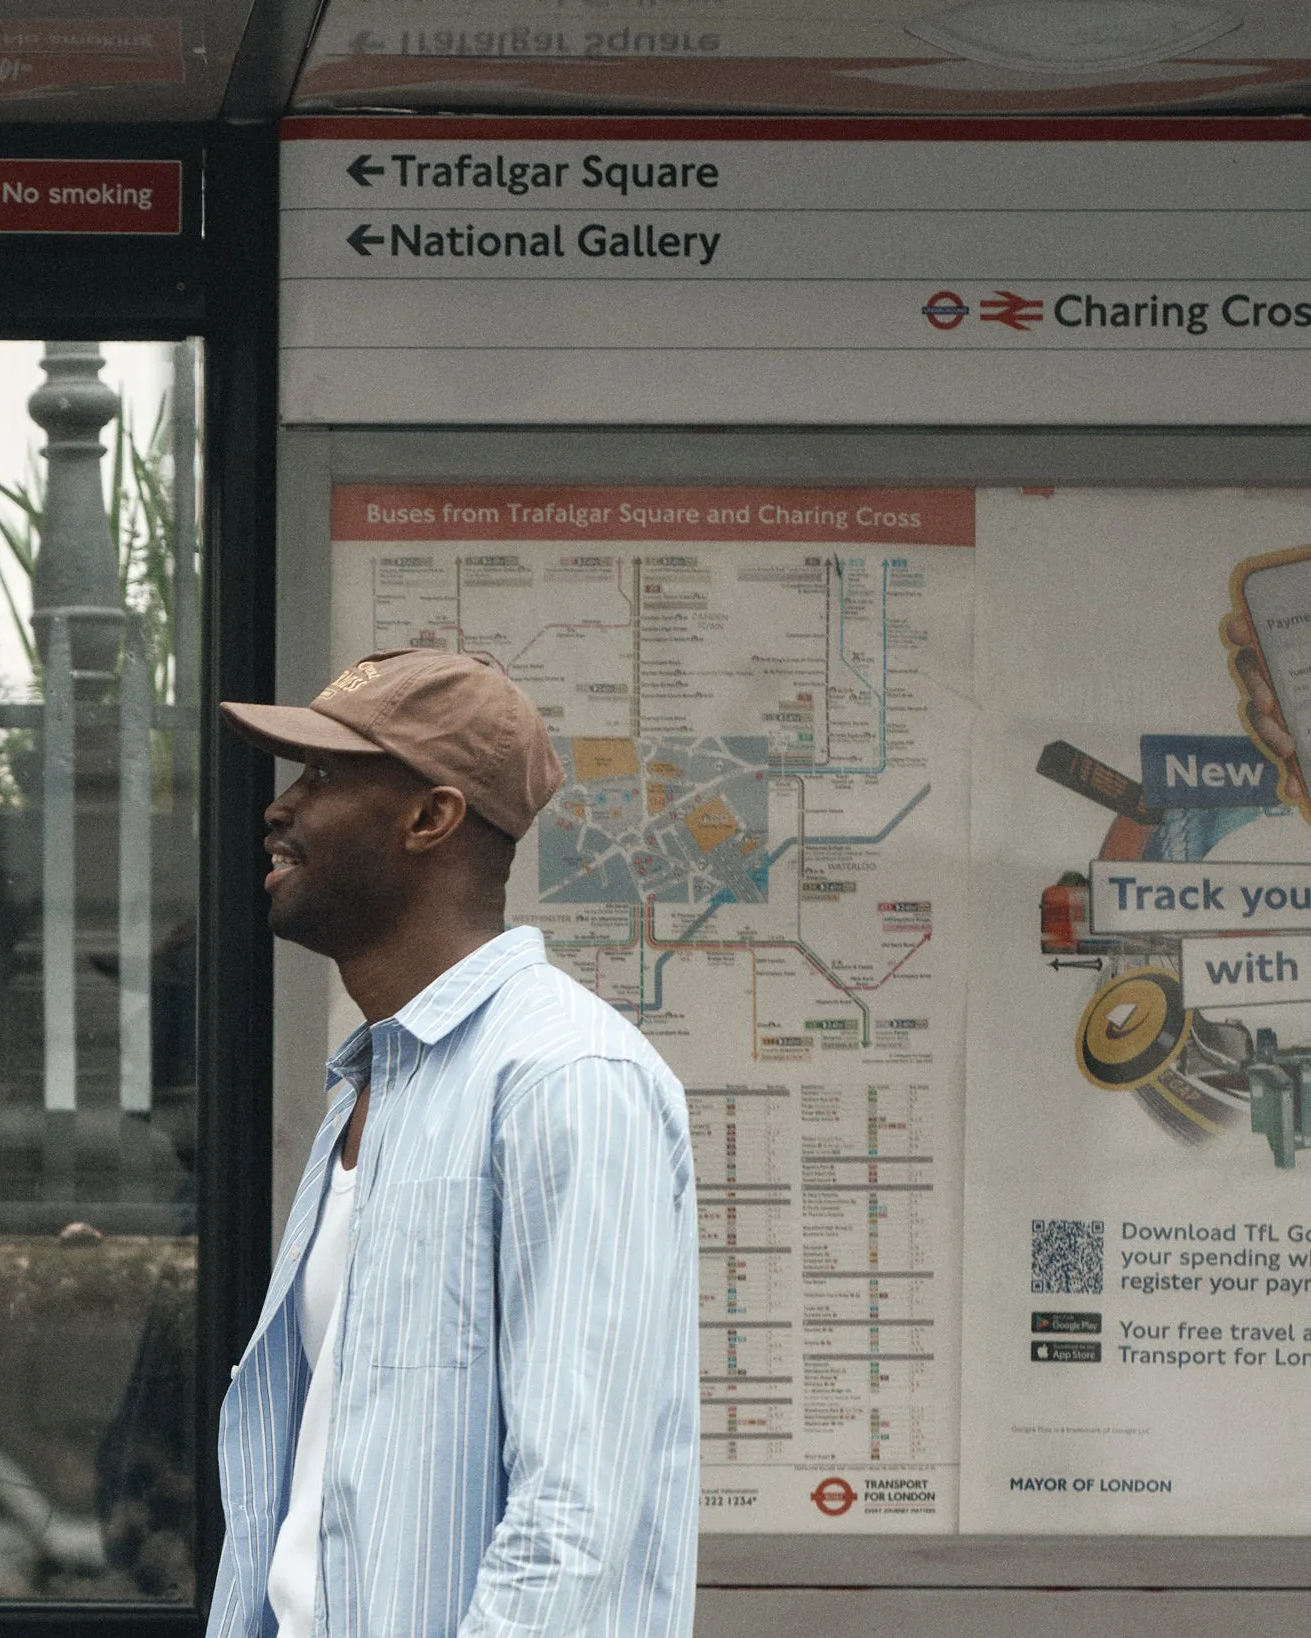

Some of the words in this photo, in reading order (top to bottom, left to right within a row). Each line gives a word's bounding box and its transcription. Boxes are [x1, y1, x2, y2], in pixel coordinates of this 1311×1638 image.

[392, 154, 569, 196] Trafalgar
[582, 155, 719, 195] Square
[3, 182, 39, 204] No
[49, 183, 152, 211] smoking
[392, 224, 565, 258] National
[578, 224, 721, 266] Gallery
[1054, 293, 1209, 336] Charing
[1222, 294, 1311, 328] Cros
[366, 504, 436, 525] Buses
[442, 504, 499, 524] from
[507, 504, 612, 528] Trafalgar
[619, 503, 700, 528] Square
[706, 504, 750, 525] and
[758, 505, 848, 530] Charing
[856, 507, 922, 528] Cross
[1165, 754, 1264, 788] New
[1108, 876, 1225, 911] Track
[1240, 886, 1311, 918] you
[1205, 950, 1299, 985] with
[1122, 1222, 1236, 1242] Download
[1244, 1224, 1280, 1242] TfL
[1121, 1251, 1172, 1269] your
[1180, 1249, 1281, 1271] spending
[1121, 1272, 1203, 1294] register
[1209, 1277, 1259, 1295] your
[1120, 1321, 1170, 1340] Your
[1177, 1322, 1223, 1340] free
[1230, 1323, 1295, 1341] travel
[1053, 1351, 1072, 1361] App
[1074, 1351, 1096, 1360] Store
[1118, 1346, 1227, 1368] Transport
[1233, 1348, 1267, 1365] for
[865, 1480, 928, 1489] TRANSPORT
[1010, 1478, 1067, 1492] MAYOR
[1073, 1479, 1094, 1492] OF
[1100, 1479, 1172, 1493] LONDON
[705, 1496, 723, 1506] 222
[864, 1492, 885, 1501] FOR
[888, 1492, 936, 1501] LONDON
